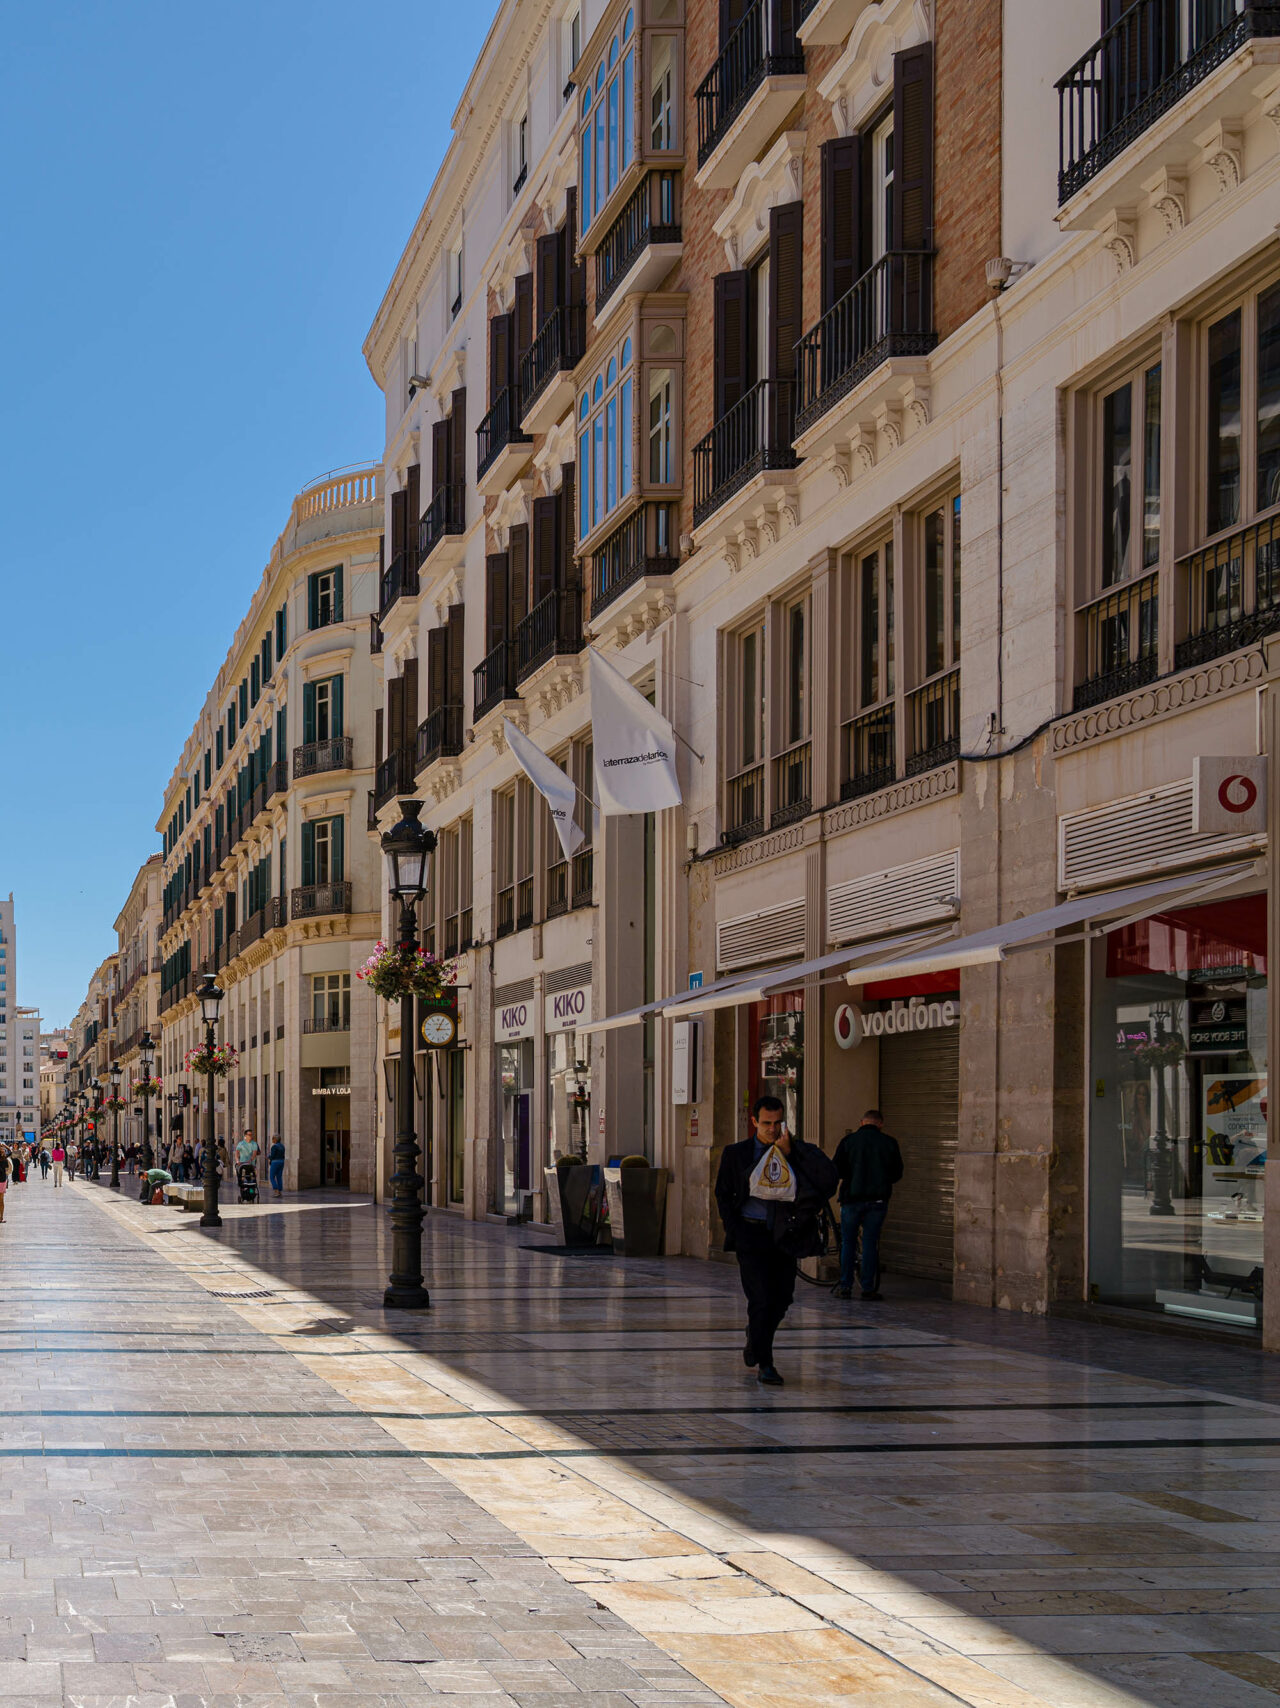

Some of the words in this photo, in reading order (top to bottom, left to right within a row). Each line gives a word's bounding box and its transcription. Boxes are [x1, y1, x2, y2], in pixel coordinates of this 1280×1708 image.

[502, 1005, 527, 1029] KIKO
[554, 990, 585, 1018] KIKO
[861, 997, 956, 1037] vodafone
[336, 1087, 352, 1095] LOLA
